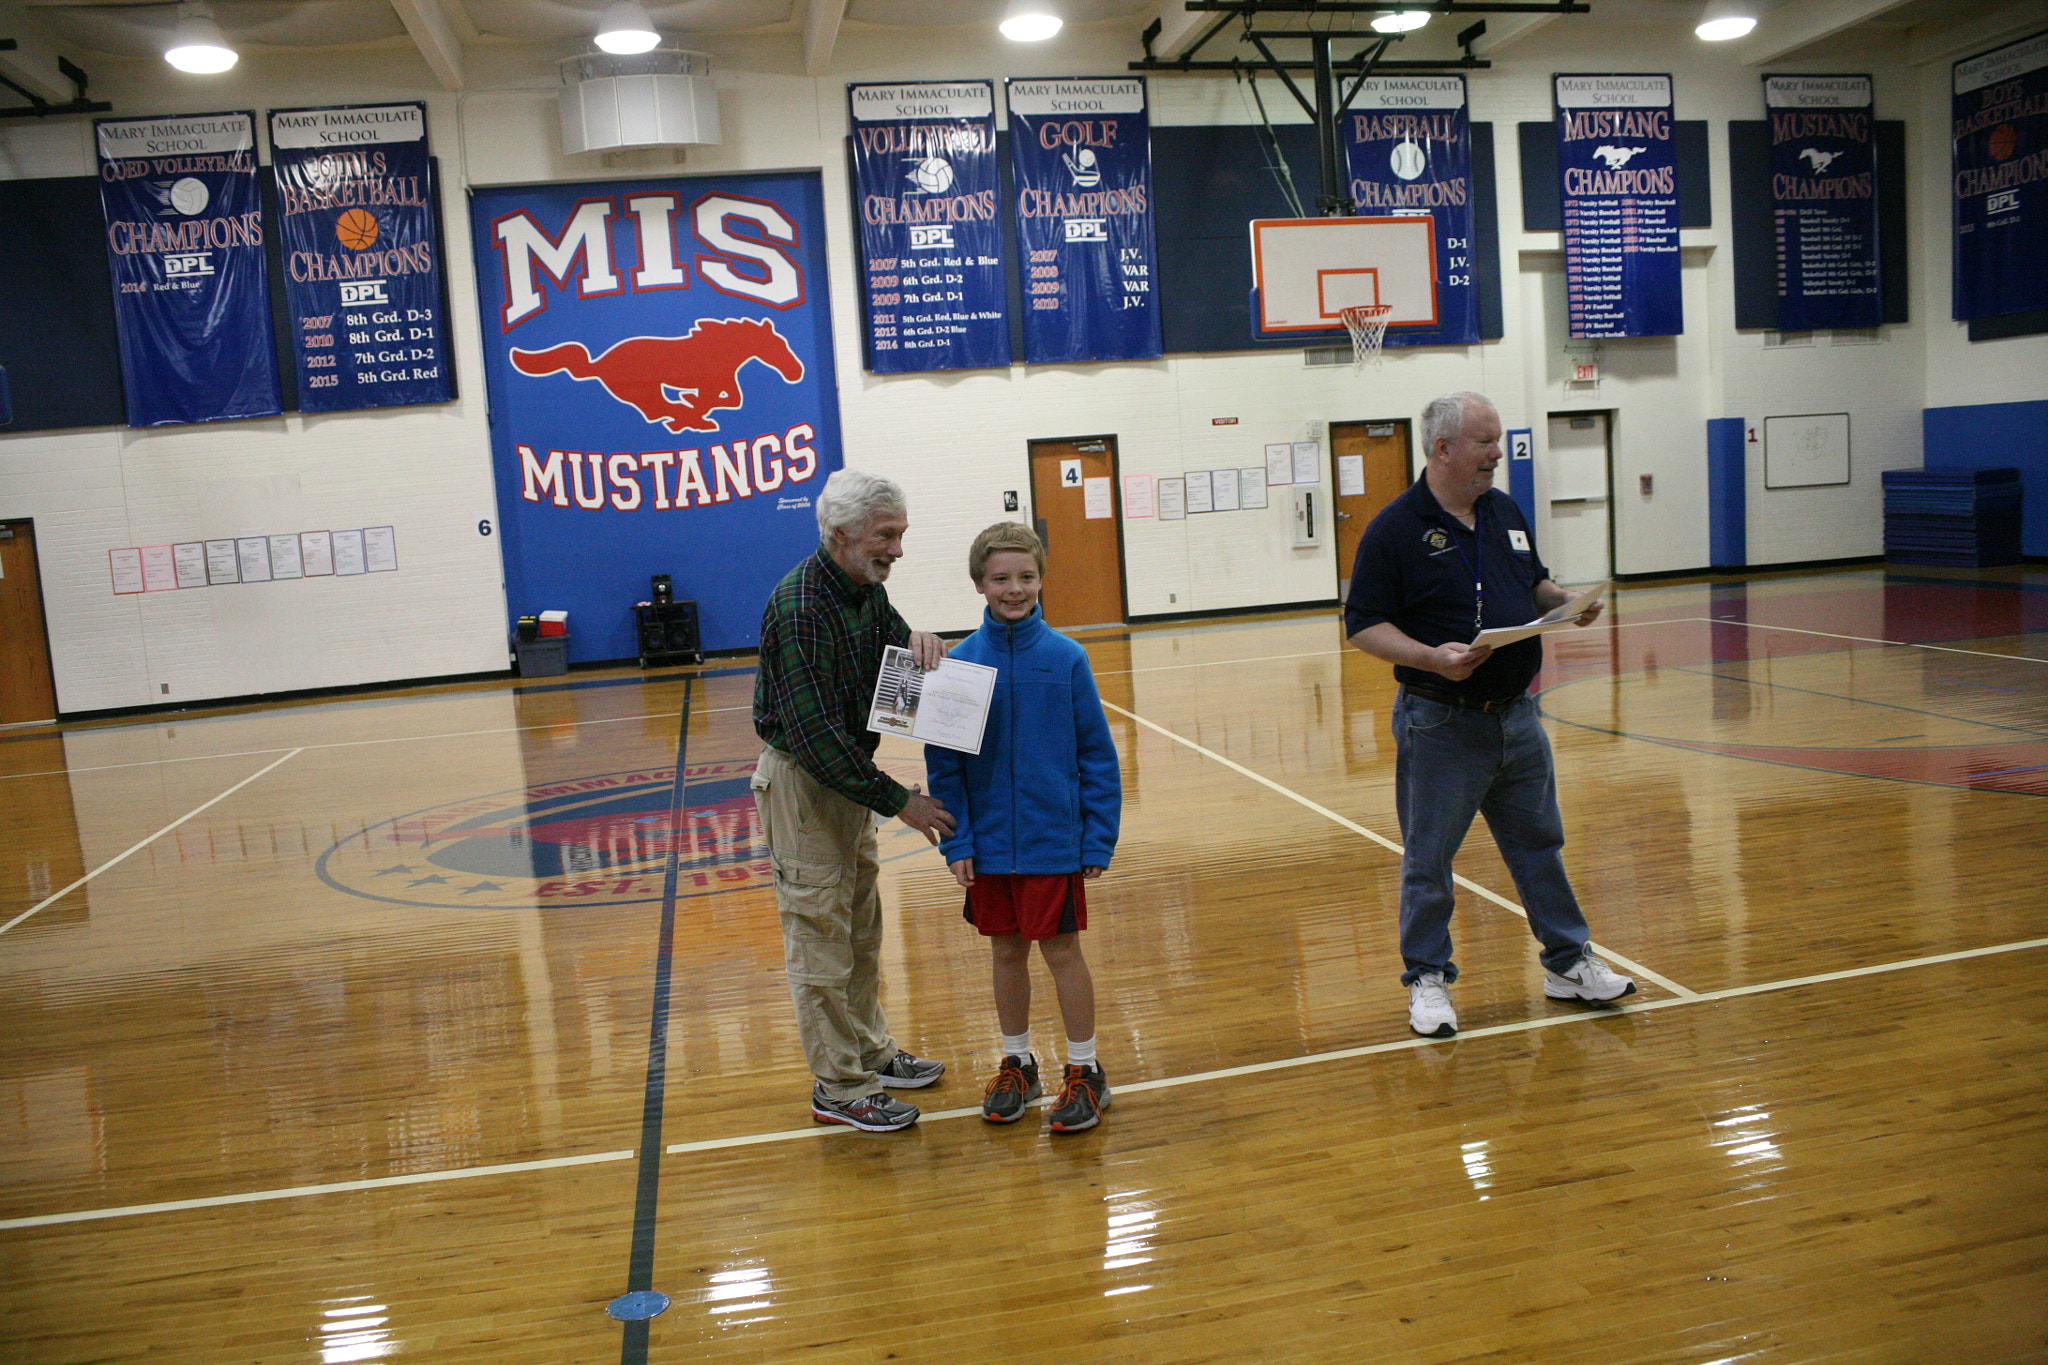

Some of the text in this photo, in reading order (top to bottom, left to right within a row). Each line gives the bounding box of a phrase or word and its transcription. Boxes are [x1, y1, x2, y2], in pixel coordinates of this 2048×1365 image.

[1014, 84, 1140, 96] MARY IMMACULATE
[1384, 79, 1460, 91] IMMACULATE
[1562, 80, 1666, 92] MARY IMMACULATE
[1770, 80, 1868, 91] MARY IMMACULATE
[857, 87, 987, 101] MARY IMMACULATE
[1380, 95, 1429, 106] SCHOOL
[1593, 93, 1638, 104] SCHOOL
[1799, 95, 1840, 106] SCHOOL
[896, 104, 952, 117] SCHOOL
[1051, 100, 1105, 111] SCHOOL
[277, 110, 418, 129] MARY IMMACULATE
[1562, 110, 1670, 142] MUSTANG
[104, 121, 245, 140] MARY IMMACULATE
[319, 129, 381, 144] SCHOOL
[1039, 119, 1118, 149] GOLF
[1353, 115, 1458, 143] BASEBALL
[1771, 113, 1869, 146] MUSTANG
[147, 139, 207, 153] SCHOOL
[858, 124, 992, 154] VOLLEYBALL
[103, 153, 256, 182] COED VOLLEYBALL
[1564, 166, 1675, 196] CHAMPIONS
[1772, 172, 1872, 200] CHAMPIONS
[283, 176, 426, 216] BASKETBALL
[1352, 177, 1466, 207] CHAMPIONS
[864, 189, 996, 225] CHAMPIONS
[1020, 184, 1147, 217] CHAMPIONS
[1987, 194, 2020, 211] DPL
[109, 211, 263, 255] CHAMPIONS
[911, 230, 954, 245] DPL
[1065, 223, 1107, 238] DPL
[1448, 238, 1468, 249] D-1
[290, 240, 431, 282] CHAMPIONS
[492, 190, 806, 335] MIS
[1030, 248, 1143, 262] 2007 J.V.
[165, 257, 215, 273] DPL
[869, 256, 999, 271] 2007 5th Grd. Red & Blue
[1122, 265, 1149, 276] VAR
[1450, 257, 1470, 270] J.V.
[153, 283, 170, 291] Red
[171, 282, 179, 290] &
[181, 281, 200, 289] Blue
[870, 274, 963, 288] 2009 6th Grd. D-2
[1031, 281, 1150, 294] 2009 VAR
[1449, 275, 1470, 286] D-2
[340, 284, 388, 302] DPL
[872, 292, 964, 306] 2009 7th Grd. D-1
[1123, 296, 1145, 310] J.V.
[302, 309, 432, 329] 2007 8th Grd. D-3
[873, 314, 896, 324] 2011
[902, 315, 915, 323] 5th
[916, 313, 933, 322] Grd.
[953, 312, 969, 320] Blue
[970, 312, 978, 320] &
[979, 311, 1002, 320] White
[305, 327, 435, 348] 2010 8th Grd. D-1
[874, 325, 967, 337] 2012 6th Grd. D-2 Blue
[875, 339, 898, 350] 2014
[918, 339, 935, 348] Grd.
[937, 339, 951, 347] D-1
[307, 348, 435, 368] 2012 7th Grd. D-2
[309, 367, 439, 388] 2015 5th Grd. Red
[1576, 364, 1595, 380] EXIT
[1748, 428, 1758, 443] 1
[1516, 442, 1527, 457] 2
[516, 422, 817, 512] MUSTANGS
[1065, 467, 1079, 484] 4
[478, 519, 492, 536] 6
